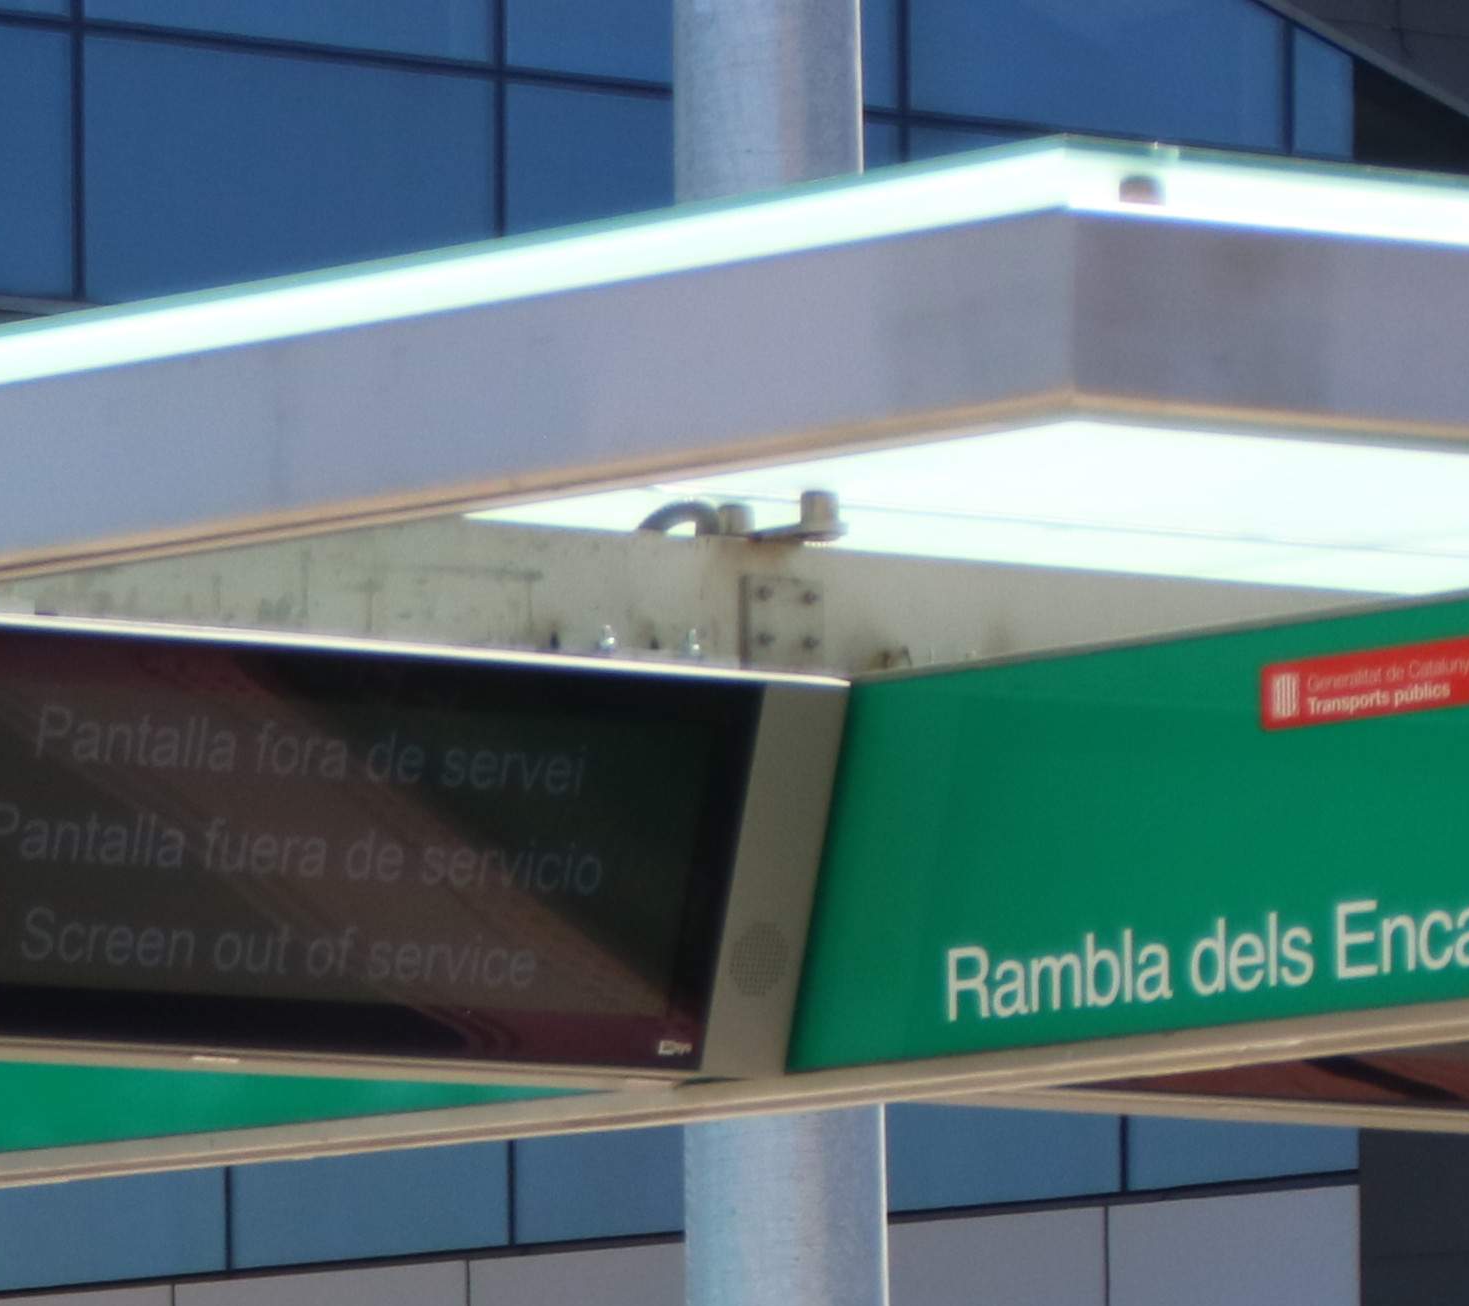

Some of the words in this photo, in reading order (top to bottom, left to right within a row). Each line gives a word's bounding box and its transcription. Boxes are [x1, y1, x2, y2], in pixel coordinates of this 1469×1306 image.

[1308, 668, 1383, 693] Generalitat
[1386, 665, 1405, 681] de
[1308, 689, 1390, 715] Transports
[1394, 682, 1451, 708] públics
[35, 703, 236, 773] Pantalla
[256, 721, 348, 780] fora
[367, 730, 426, 785] de
[440, 744, 588, 795] servei
[204, 816, 327, 879] fuera
[343, 830, 405, 882] de
[420, 841, 604, 897] servicio
[20, 905, 197, 970] Screen
[212, 923, 291, 975] out
[305, 926, 361, 979] of
[365, 934, 537, 989] service
[947, 929, 1172, 1022] Rambla
[1190, 914, 1315, 994] dels
